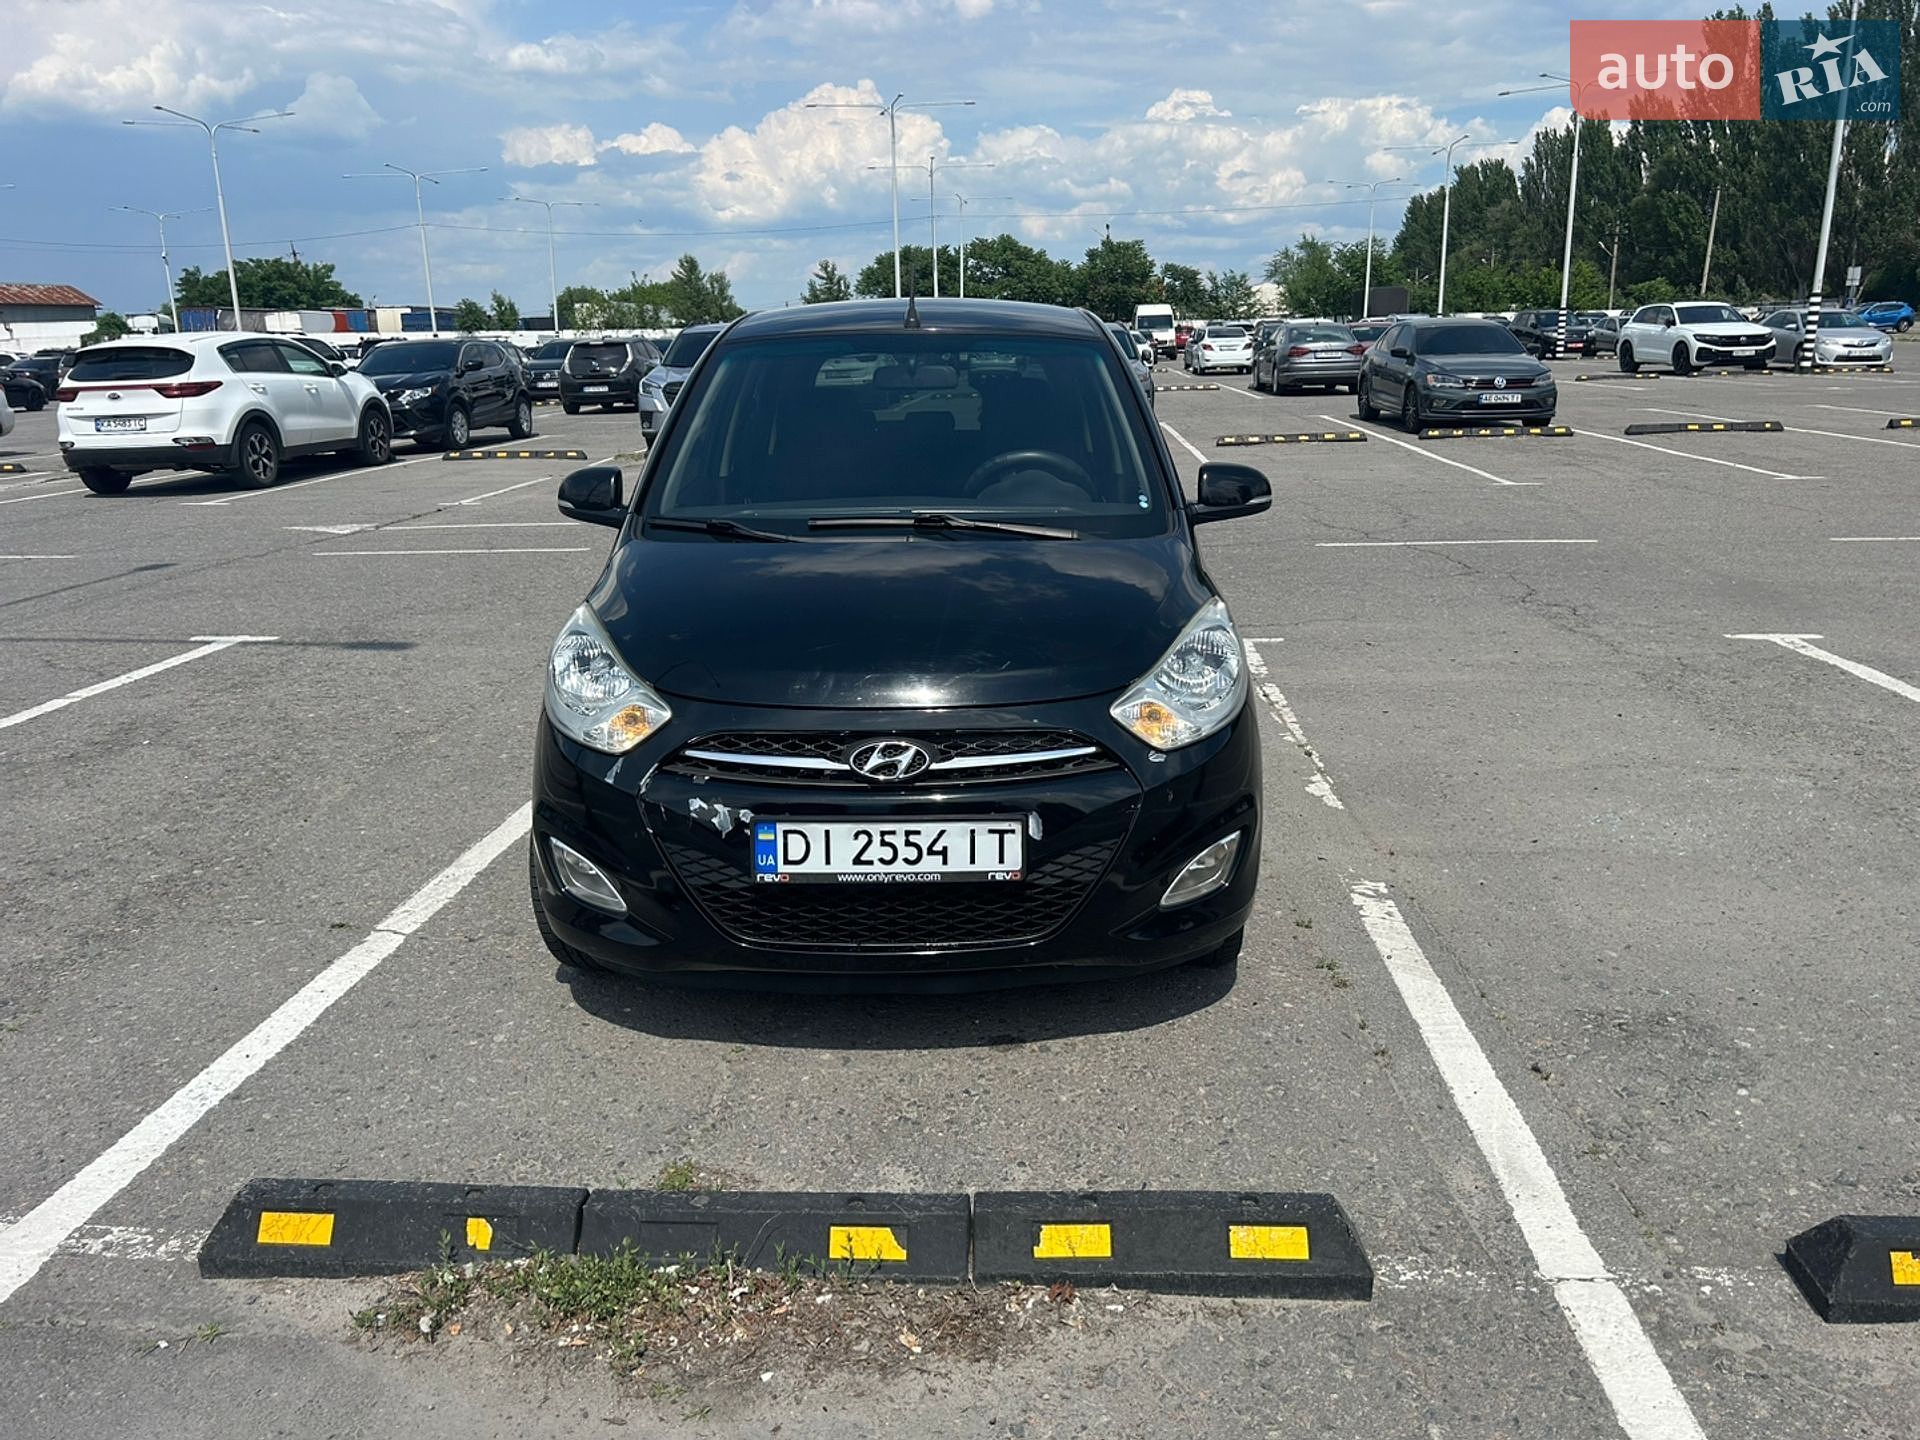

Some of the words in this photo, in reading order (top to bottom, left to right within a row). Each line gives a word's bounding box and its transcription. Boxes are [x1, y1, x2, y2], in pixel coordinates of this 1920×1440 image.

[782, 829, 831, 866] DI
[852, 829, 949, 866] 2554
[969, 828, 1016, 865] IT
[757, 854, 776, 867] UA
[756, 873, 789, 882] revo
[837, 872, 942, 883] www.onlyrevo.com
[988, 872, 1021, 881] revo
